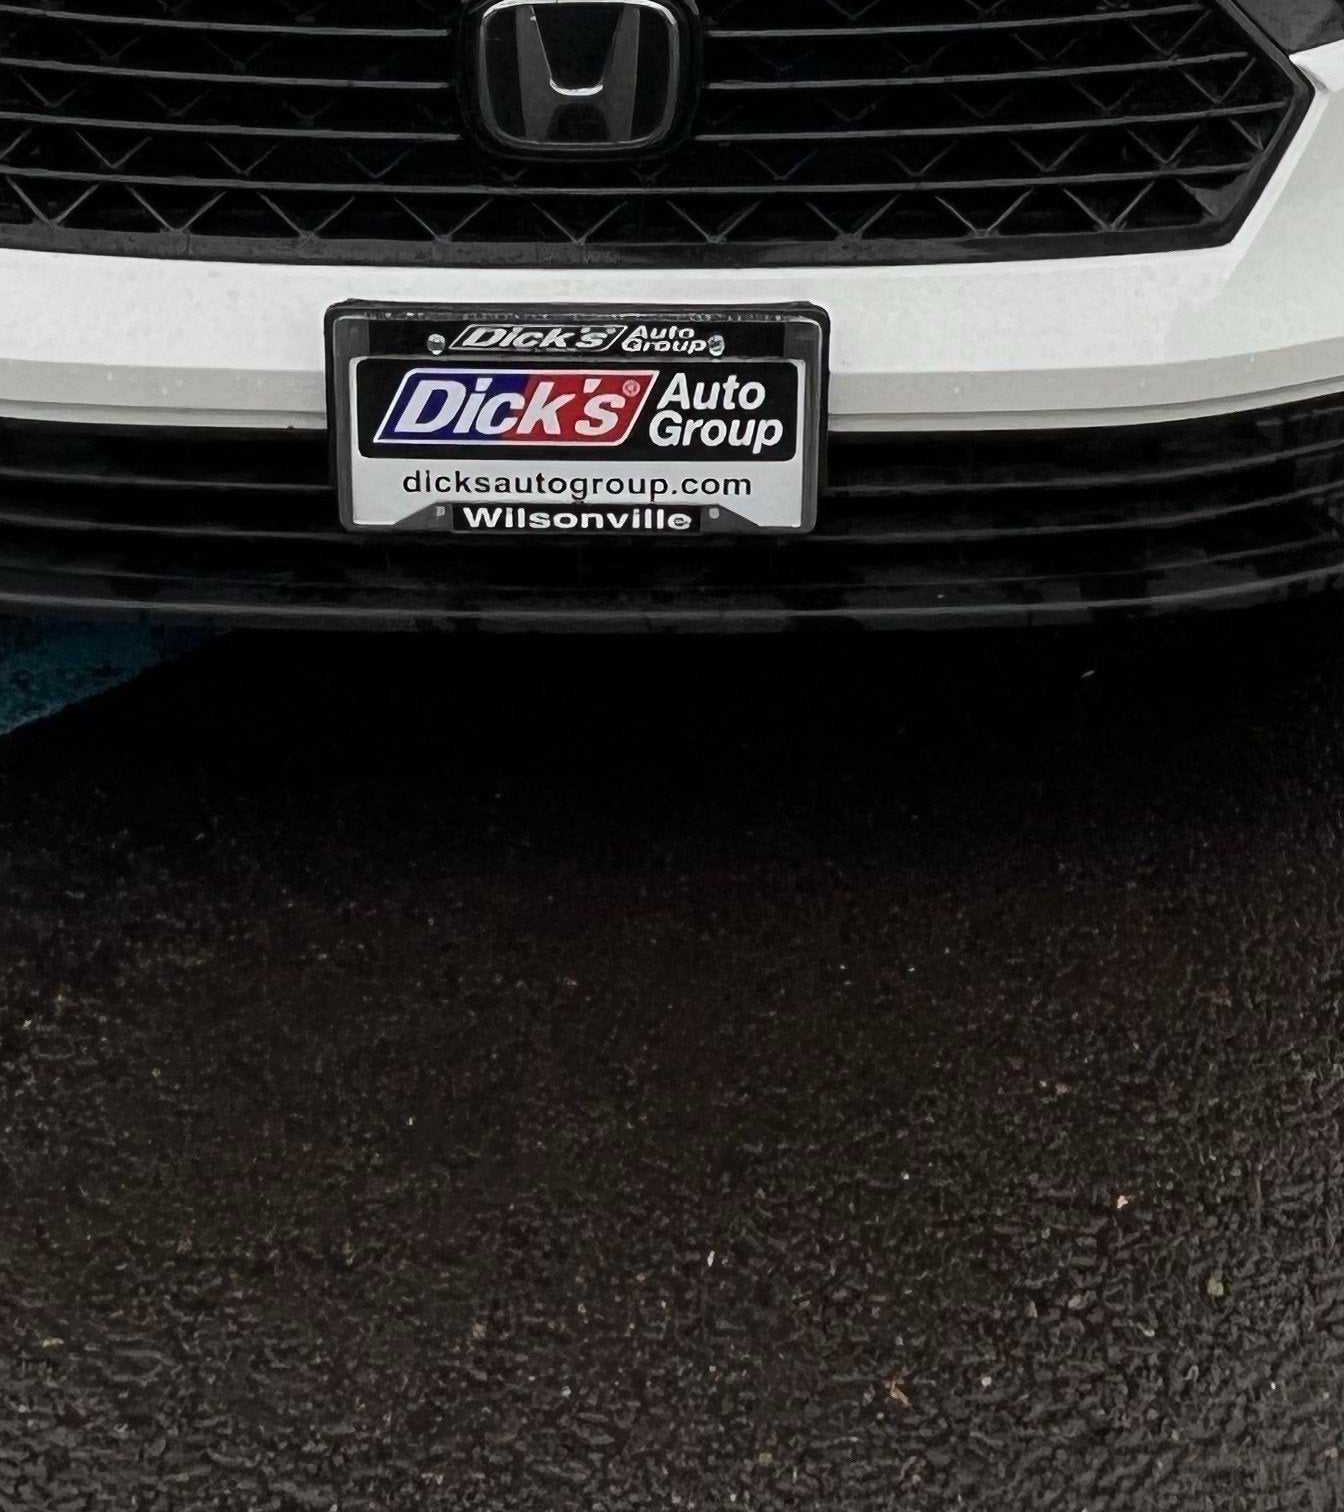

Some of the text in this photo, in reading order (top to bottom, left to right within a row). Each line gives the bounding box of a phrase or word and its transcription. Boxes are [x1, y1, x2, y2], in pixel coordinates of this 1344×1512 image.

[462, 325, 695, 349] Dick's Auto
[621, 338, 707, 355] Group
[393, 373, 765, 436] Dick's Auto
[648, 413, 784, 455] Group
[402, 470, 752, 502] dicksautogroup.com
[462, 506, 693, 530] Wilsonville
